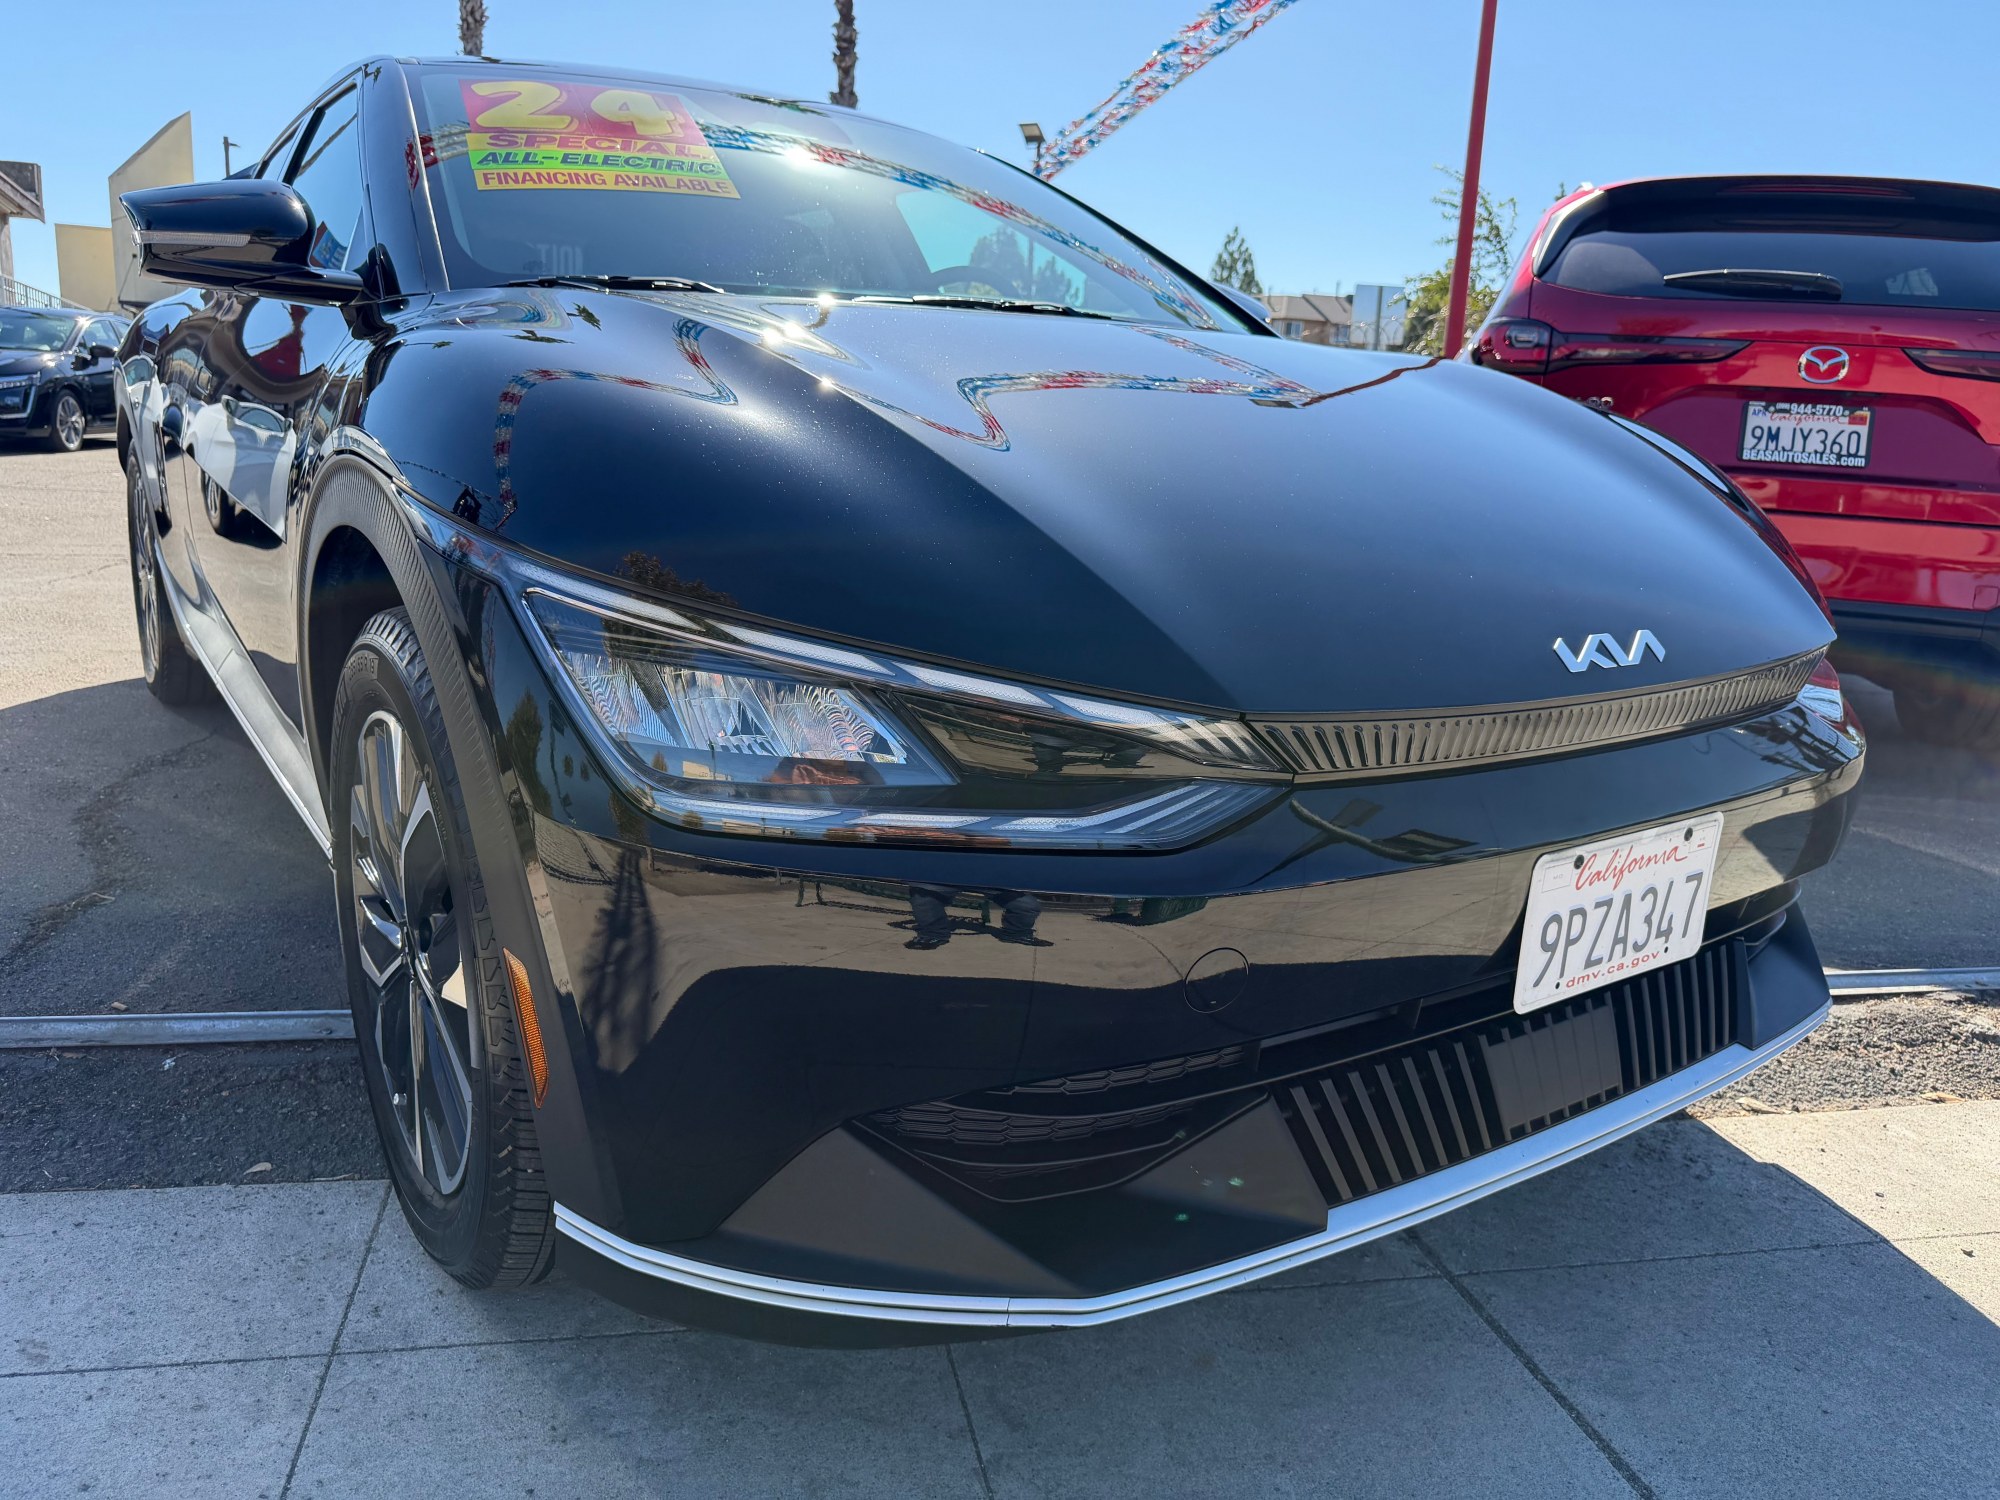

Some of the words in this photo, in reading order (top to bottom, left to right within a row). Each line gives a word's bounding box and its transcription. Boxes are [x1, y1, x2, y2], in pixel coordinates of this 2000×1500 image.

[470, 81, 682, 138] 24
[489, 134, 704, 158] SPECIAL
[477, 151, 722, 176] ALL-ELECTRIC
[484, 171, 606, 186] FINANCING
[614, 174, 730, 195] AVAILABLE
[1791, 403, 1843, 417] 944-5770
[1750, 425, 1861, 455] 9MJY360
[1743, 449, 1865, 467] BEASAUTOSALES.com
[1553, 629, 1666, 673] KIA
[1575, 845, 1688, 891] California
[1532, 871, 1704, 988] 9PZA347
[1566, 951, 1660, 988] dmv.ca.gov
